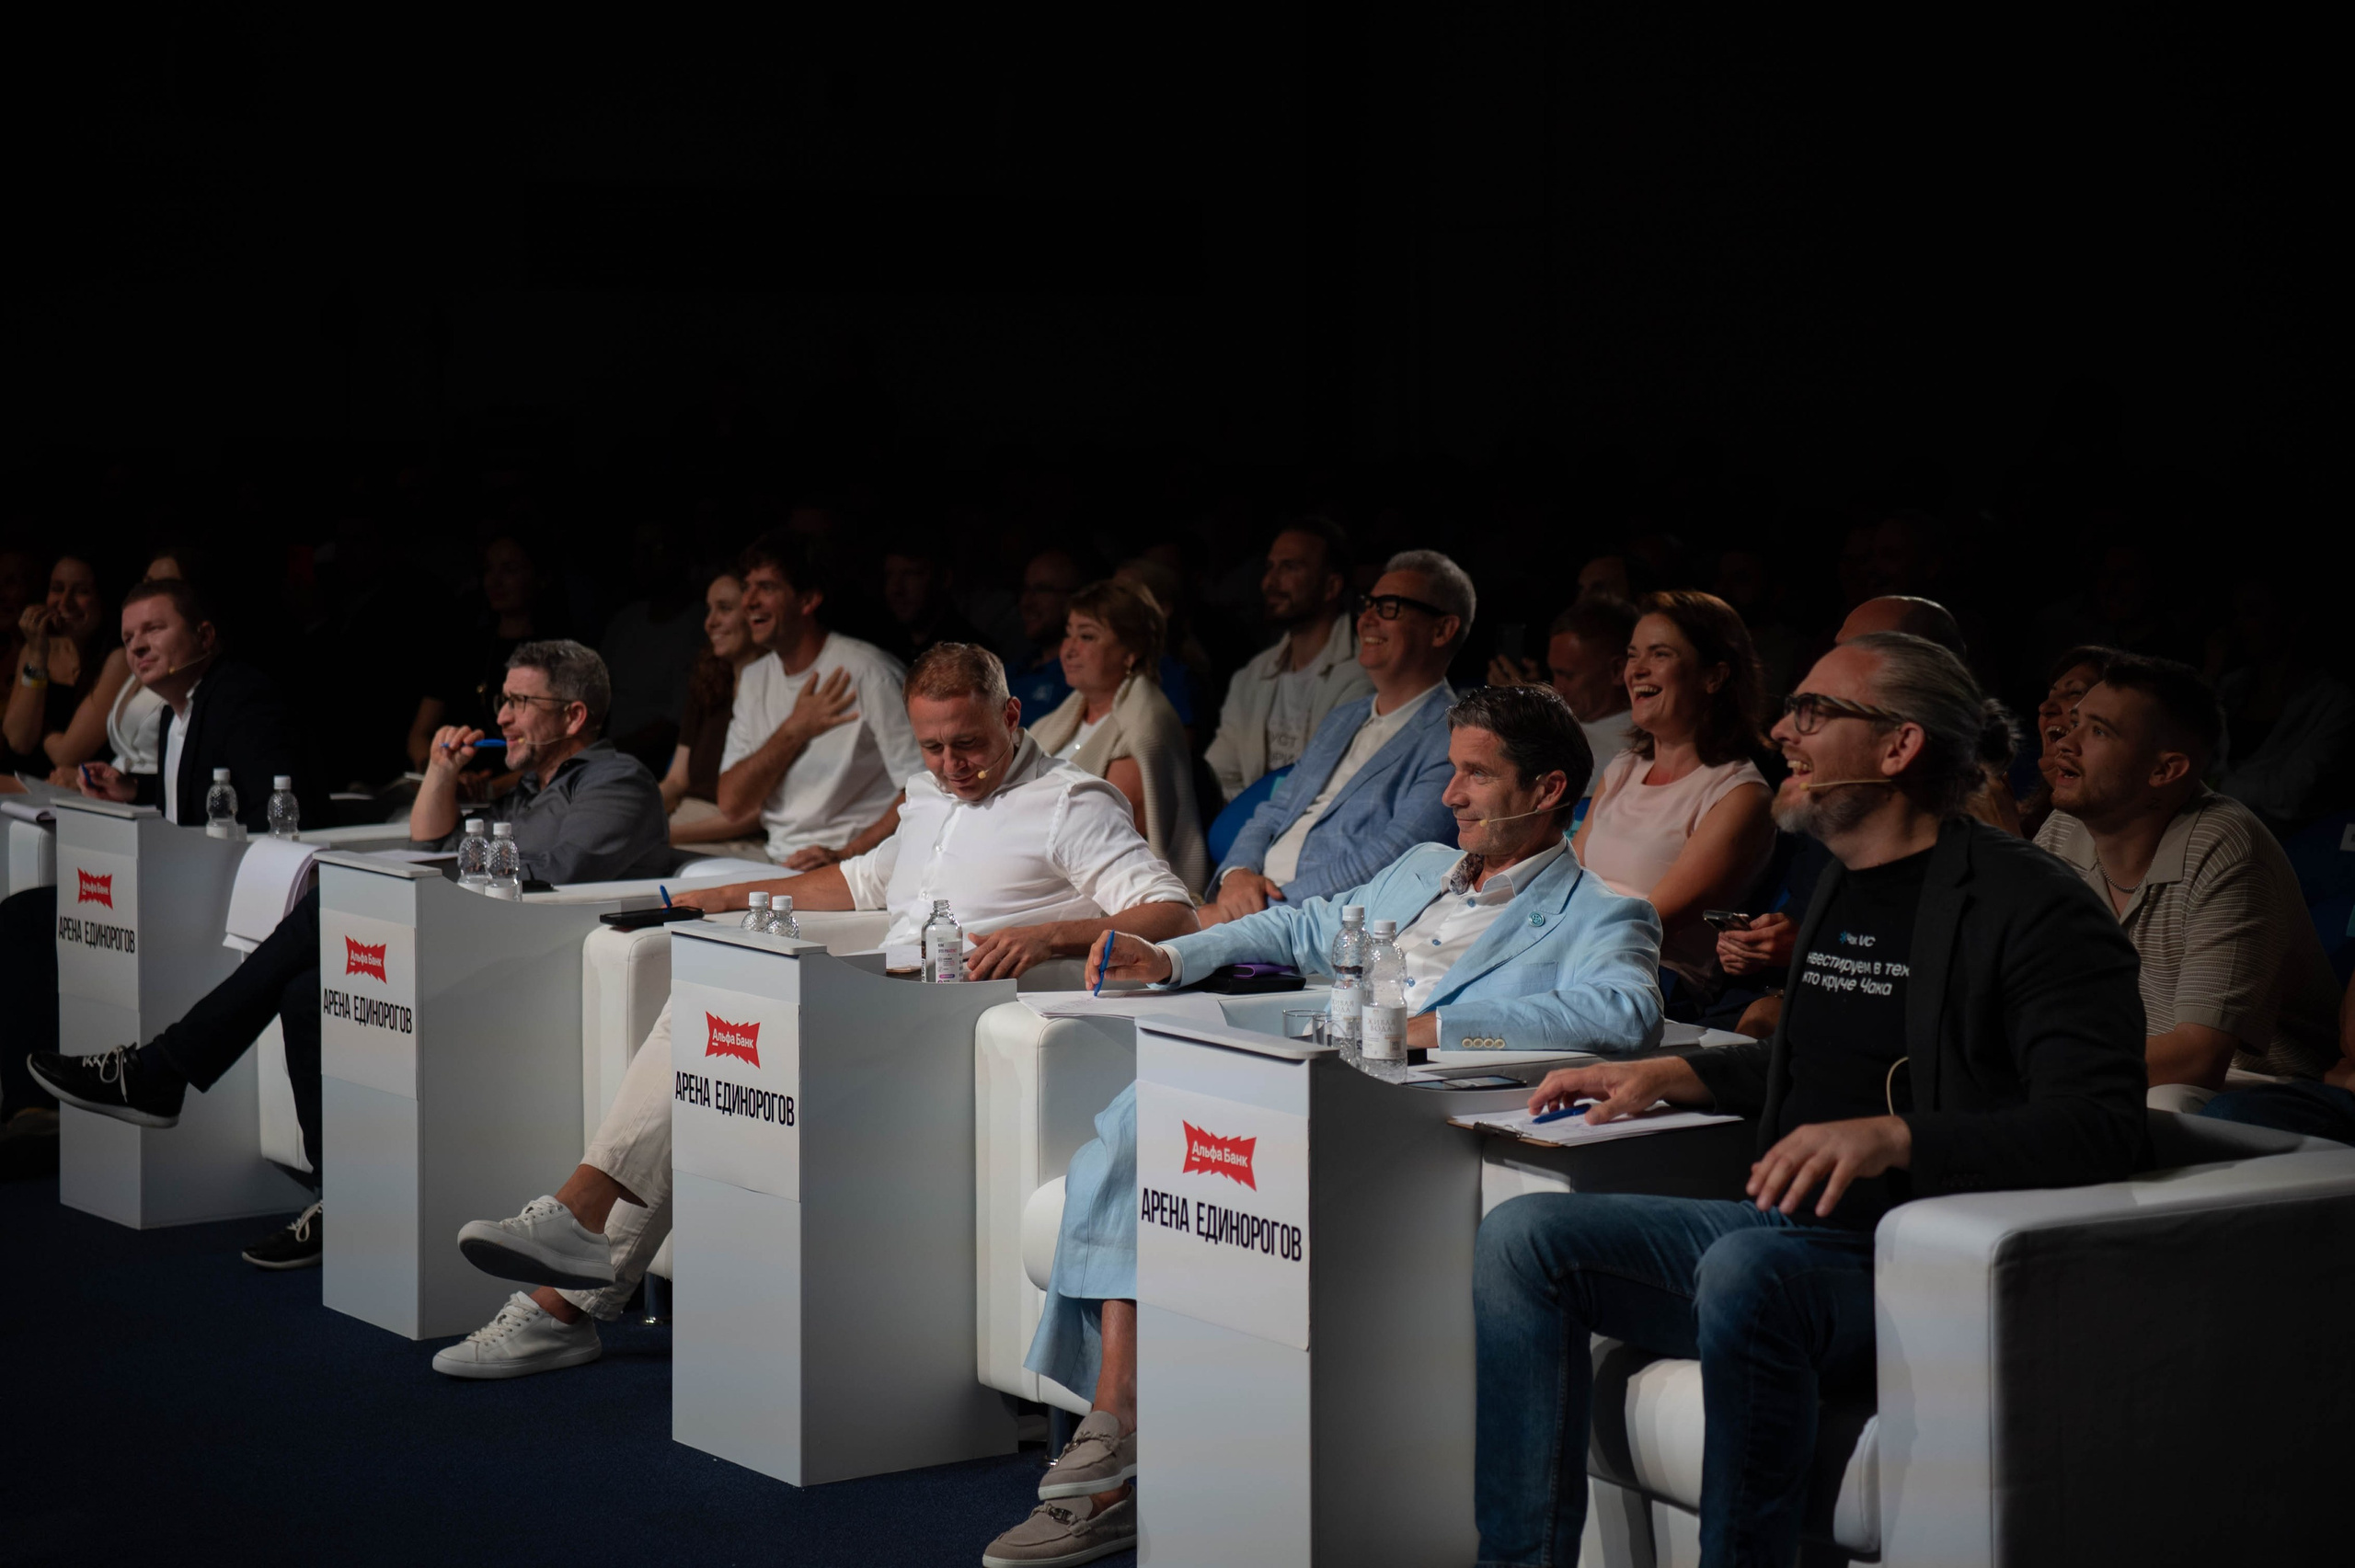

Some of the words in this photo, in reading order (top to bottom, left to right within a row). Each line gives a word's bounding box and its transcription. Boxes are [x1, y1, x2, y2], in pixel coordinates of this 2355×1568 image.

[59, 915, 82, 943] АРЕНА
[85, 921, 135, 954] ЕДИНОРОГОВ
[1858, 934, 1876, 947] VC
[350, 949, 368, 966] Альфа
[368, 954, 383, 967] Банк
[1806, 951, 1871, 975] нвестируем
[1802, 971, 1821, 985] кто
[1821, 975, 1857, 992] круче
[1859, 977, 1893, 996] Чака
[324, 988, 350, 1020] АРЕНА
[354, 995, 412, 1035] ЕДИНОРОГОВ
[712, 1028, 735, 1047] Альфа
[736, 1033, 754, 1048] Банк
[675, 1070, 711, 1108] АРЕНА
[716, 1080, 795, 1127] ЕДИНОРОГОВ
[1191, 1140, 1223, 1162] Альфа
[1223, 1148, 1248, 1168] Банк
[1141, 1187, 1189, 1233] АРЕНА
[1196, 1201, 1303, 1263] ЕДИНОРОГОВ
